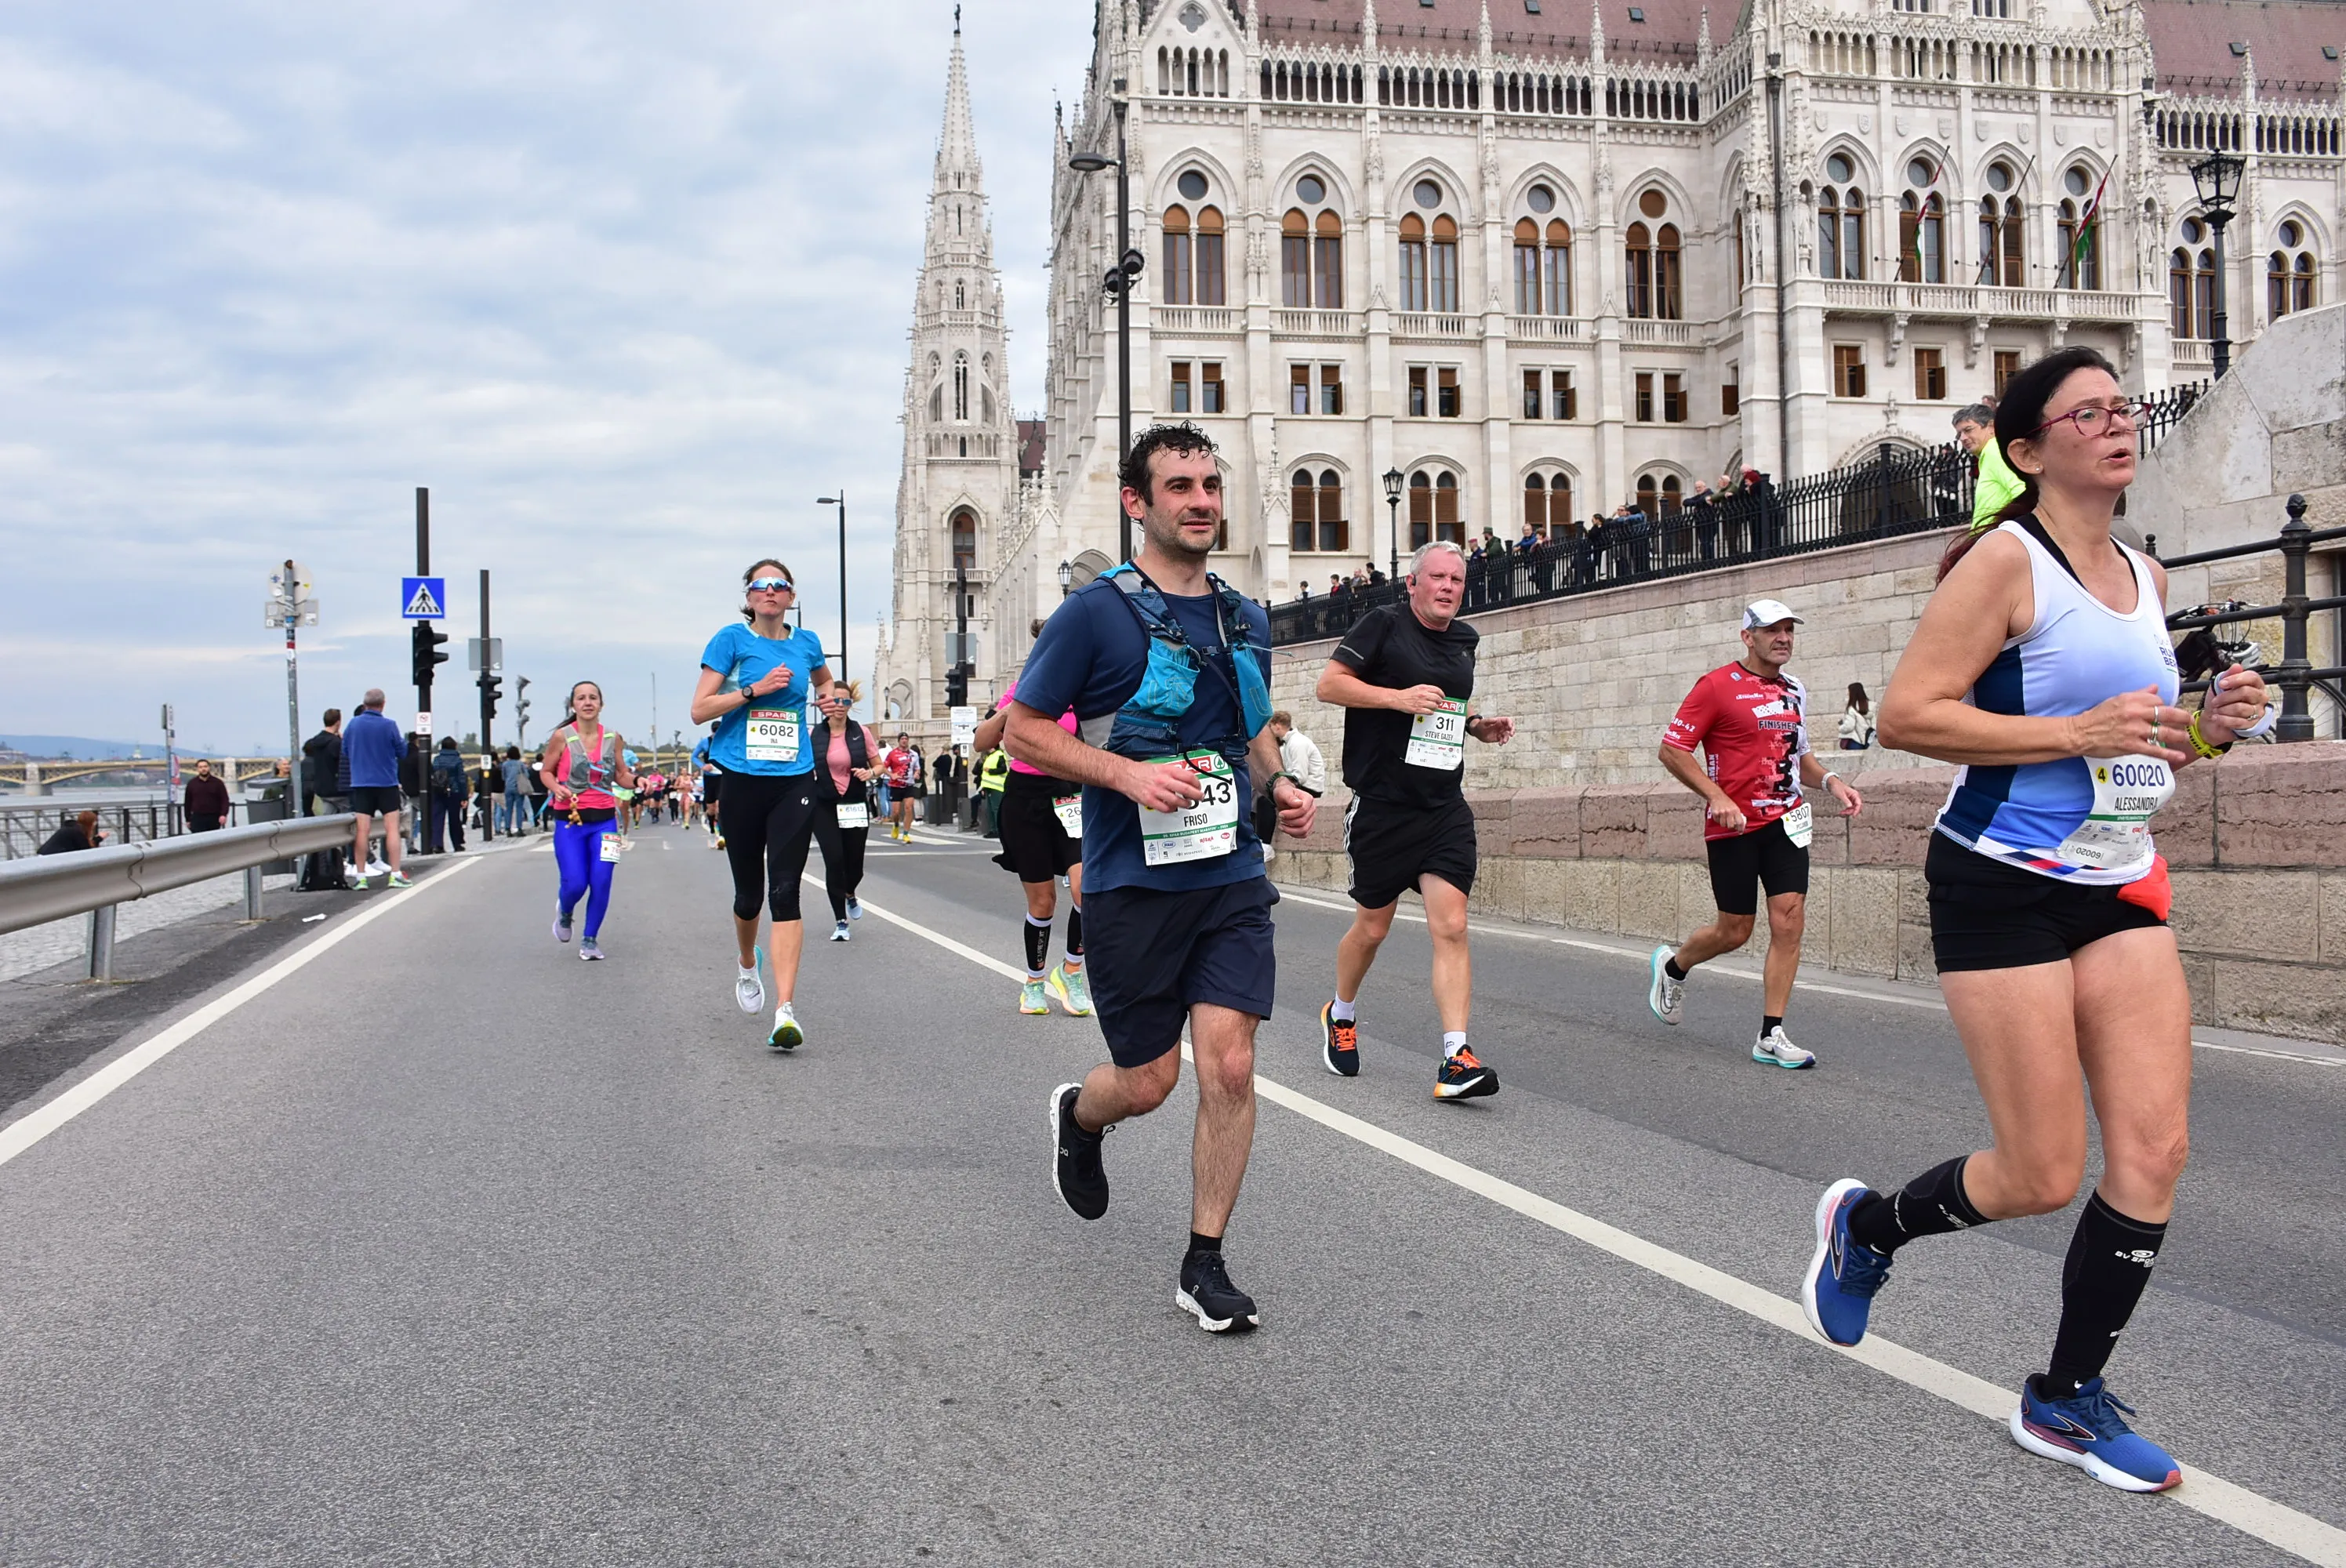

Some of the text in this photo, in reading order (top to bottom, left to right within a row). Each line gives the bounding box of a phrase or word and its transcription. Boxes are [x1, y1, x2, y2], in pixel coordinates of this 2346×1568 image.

[760, 724, 794, 737] 6082
[1436, 717, 1454, 731] 311
[1758, 720, 1797, 732] FINISHER
[1425, 731, 1440, 739] STEVE
[2098, 764, 2165, 786] 4 60020
[2114, 797, 2158, 811] ALESSANDRA
[1183, 813, 1208, 827] FRISO
[1789, 806, 1809, 822] 5807
[2075, 847, 2101, 859] 60020
[2115, 1250, 2130, 1259] BV
